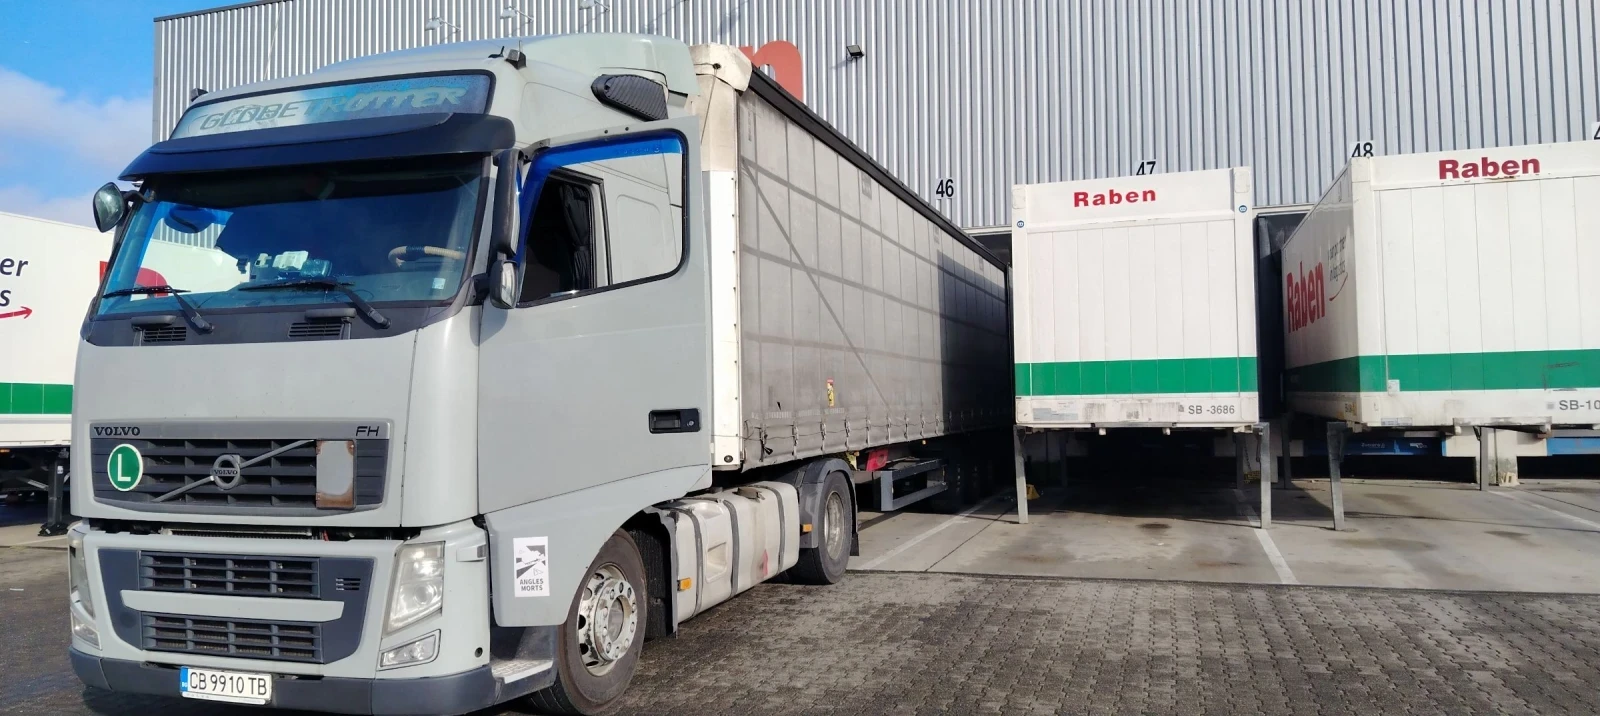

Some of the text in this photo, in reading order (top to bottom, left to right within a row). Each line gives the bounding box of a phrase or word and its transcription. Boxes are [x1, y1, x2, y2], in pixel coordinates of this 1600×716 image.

[200, 86, 468, 130] GLOBETROTTER
[1351, 142, 1373, 157] 48
[1136, 161, 1156, 176] 47
[1439, 157, 1541, 179] Raben
[935, 179, 954, 198] 46
[1073, 189, 1156, 207] Raben
[0, 257, 28, 276] er
[1286, 261, 1325, 333] Raben
[1189, 405, 1235, 414] SB -3686
[94, 426, 141, 436] VOLVO
[355, 426, 380, 437] FH
[117, 454, 131, 482] L
[190, 672, 267, 696] CB 9910 TB
